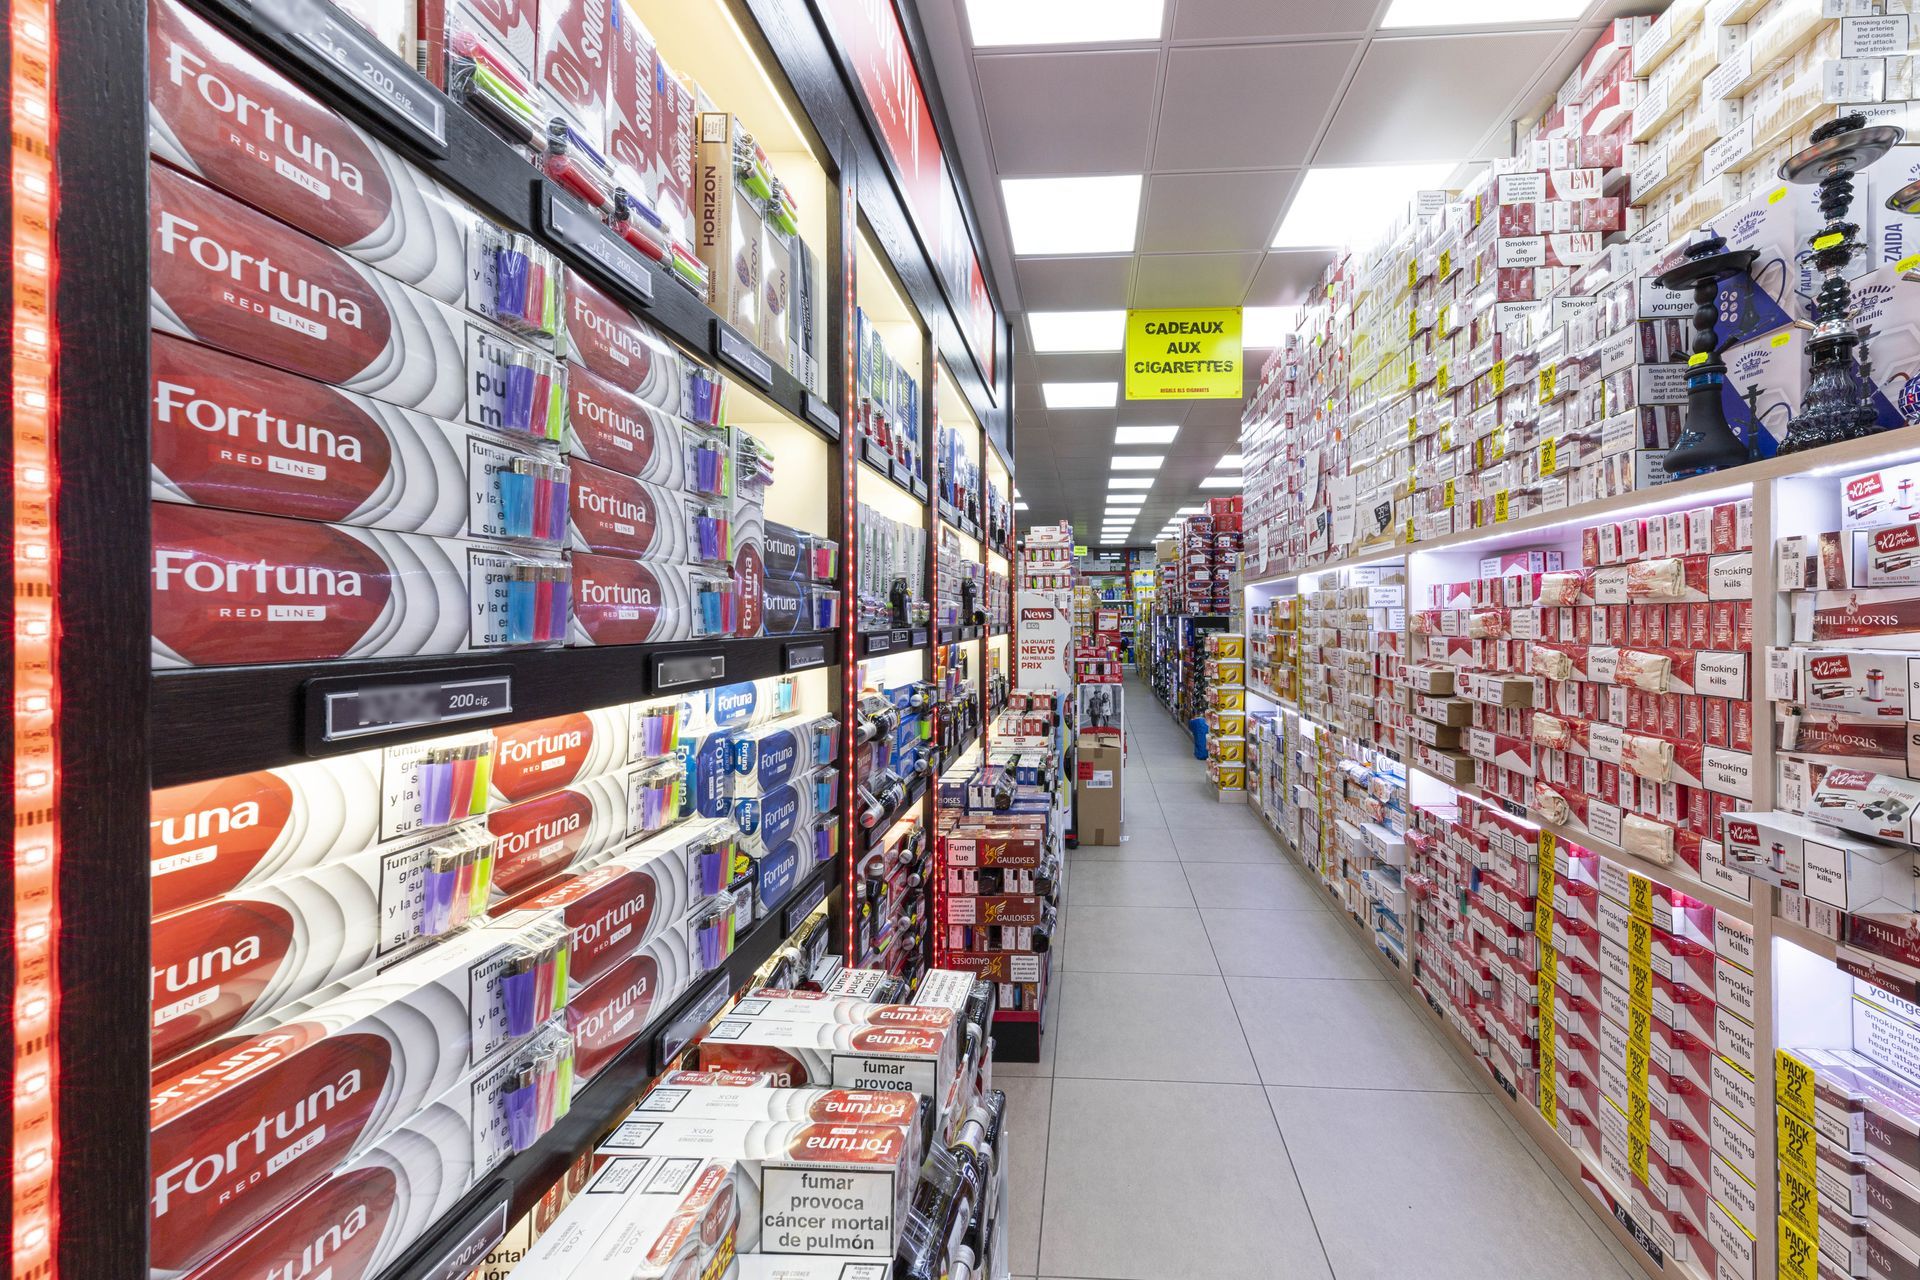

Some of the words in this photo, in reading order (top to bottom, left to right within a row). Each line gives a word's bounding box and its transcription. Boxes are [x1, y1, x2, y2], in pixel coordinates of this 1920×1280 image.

[362, 62, 394, 94] 200
[166, 41, 364, 195] Fortuna
[1850, 108, 1896, 117] Smokers
[1710, 128, 1745, 157] Smokers
[1721, 145, 1733, 156] die
[229, 133, 270, 163] RED
[281, 162, 322, 193] LINE
[1635, 155, 1661, 179] Smokers
[1711, 147, 1743, 174] younger
[1570, 171, 1594, 190] L&M
[1636, 172, 1660, 195] younger
[704, 166, 716, 247] HORIZON
[1570, 234, 1594, 252] L&M
[1884, 223, 1903, 263] ZAIDA
[1507, 256, 1537, 264] younger
[156, 211, 363, 329] Fortuna
[1666, 292, 1681, 300] die
[223, 292, 265, 314] RED
[276, 311, 318, 335] LINE
[1652, 302, 1694, 318] younger
[575, 297, 642, 359] Fortuna
[1145, 321, 1224, 335] CADEAUX
[1166, 341, 1201, 354] AUX
[1603, 336, 1633, 356] Smoking
[1134, 360, 1233, 373] CIGARETTES
[153, 381, 362, 463] Fortuna
[577, 392, 645, 441] Fortuna
[220, 450, 263, 466] RED
[274, 461, 317, 477] LINE
[1852, 483, 1863, 498] X2
[578, 485, 646, 523] Fortuna
[600, 521, 613, 529] RED
[1881, 533, 1895, 549] X2
[151, 550, 362, 597] Fortuna
[1714, 566, 1752, 577] Smoking
[1599, 577, 1625, 586] Smoking
[1724, 579, 1741, 588] kills
[582, 580, 651, 604] Fortuna
[744, 557, 753, 630] Fortuna
[219, 607, 262, 618] RED
[274, 608, 317, 618] LINE
[478, 603, 485, 614] y
[1024, 610, 1052, 619] News
[1814, 615, 1898, 626] PHILIPMORRIS
[1021, 646, 1055, 654] NEWS
[1591, 655, 1617, 665] Smoking
[1817, 661, 1829, 676] X2
[1700, 664, 1738, 676] Smoking
[1709, 677, 1727, 686] kills
[449, 693, 475, 709] 200
[475, 695, 490, 706] cig.
[718, 691, 753, 712] Fortuna
[500, 730, 581, 765] Fortuna
[1593, 733, 1619, 746] Smoking
[1799, 728, 1877, 749] PHILIPMORRIS
[761, 746, 793, 770] Fortuna
[1708, 759, 1748, 776] Smoking
[1718, 773, 1737, 785] kills
[765, 803, 795, 829] Fortuna
[497, 812, 580, 859] Fortuna
[949, 843, 975, 851] Fumer
[763, 855, 795, 884] Fortuna
[1715, 868, 1733, 882] kills
[1808, 862, 1842, 880] Smoking
[1816, 873, 1833, 884] kills
[1635, 889, 1644, 904] 22
[572, 893, 645, 952] Fortuna
[997, 914, 1035, 922] GAULOISES
[1606, 920, 1620, 933] kills
[1632, 921, 1647, 938] PACK
[1634, 935, 1643, 949] 22
[1729, 939, 1749, 956] kills
[829, 970, 852, 993] fumar
[862, 972, 881, 999] matar
[162, 993, 209, 1020] LINE
[1730, 989, 1751, 1008] kills
[1869, 985, 1920, 1015] younge
[576, 976, 647, 1047] Fortuna
[1632, 1008, 1647, 1025] PACK
[1635, 1021, 1644, 1037] 22
[1864, 1010, 1904, 1037] Smoking
[1871, 1022, 1886, 1034] the
[866, 1032, 935, 1048] Fortuna
[1868, 1037, 1892, 1056] heart
[1872, 1032, 1889, 1045] and
[1872, 1048, 1889, 1062] and
[863, 1060, 905, 1076] fumar
[1782, 1057, 1808, 1085] PACK
[855, 1076, 913, 1091] provoca
[1714, 1067, 1756, 1107] Smoking
[1787, 1075, 1802, 1098] 22
[1725, 1088, 1744, 1109] kills
[825, 1103, 905, 1118] Fortuna
[1712, 1116, 1755, 1160] Smoking
[1784, 1115, 1809, 1145] PACK
[151, 1068, 361, 1218] Fortuna
[806, 1136, 893, 1155] Fortuna
[1724, 1137, 1743, 1160] kills
[1788, 1133, 1803, 1157] 22
[219, 1171, 260, 1204] RED
[274, 1135, 315, 1168] LINE
[801, 1173, 854, 1190] fumar
[1786, 1173, 1811, 1204] PACK
[791, 1196, 864, 1211] provoca
[1790, 1191, 1805, 1216] 22
[765, 1212, 825, 1228] cáncer
[831, 1216, 889, 1230] mortal
[779, 1232, 800, 1247] de
[807, 1234, 874, 1251] pulmón
[1709, 1212, 1750, 1260] Smoking
[1785, 1226, 1811, 1260] PACK
[1720, 1237, 1739, 1260] kills
[1789, 1246, 1804, 1270] 22
